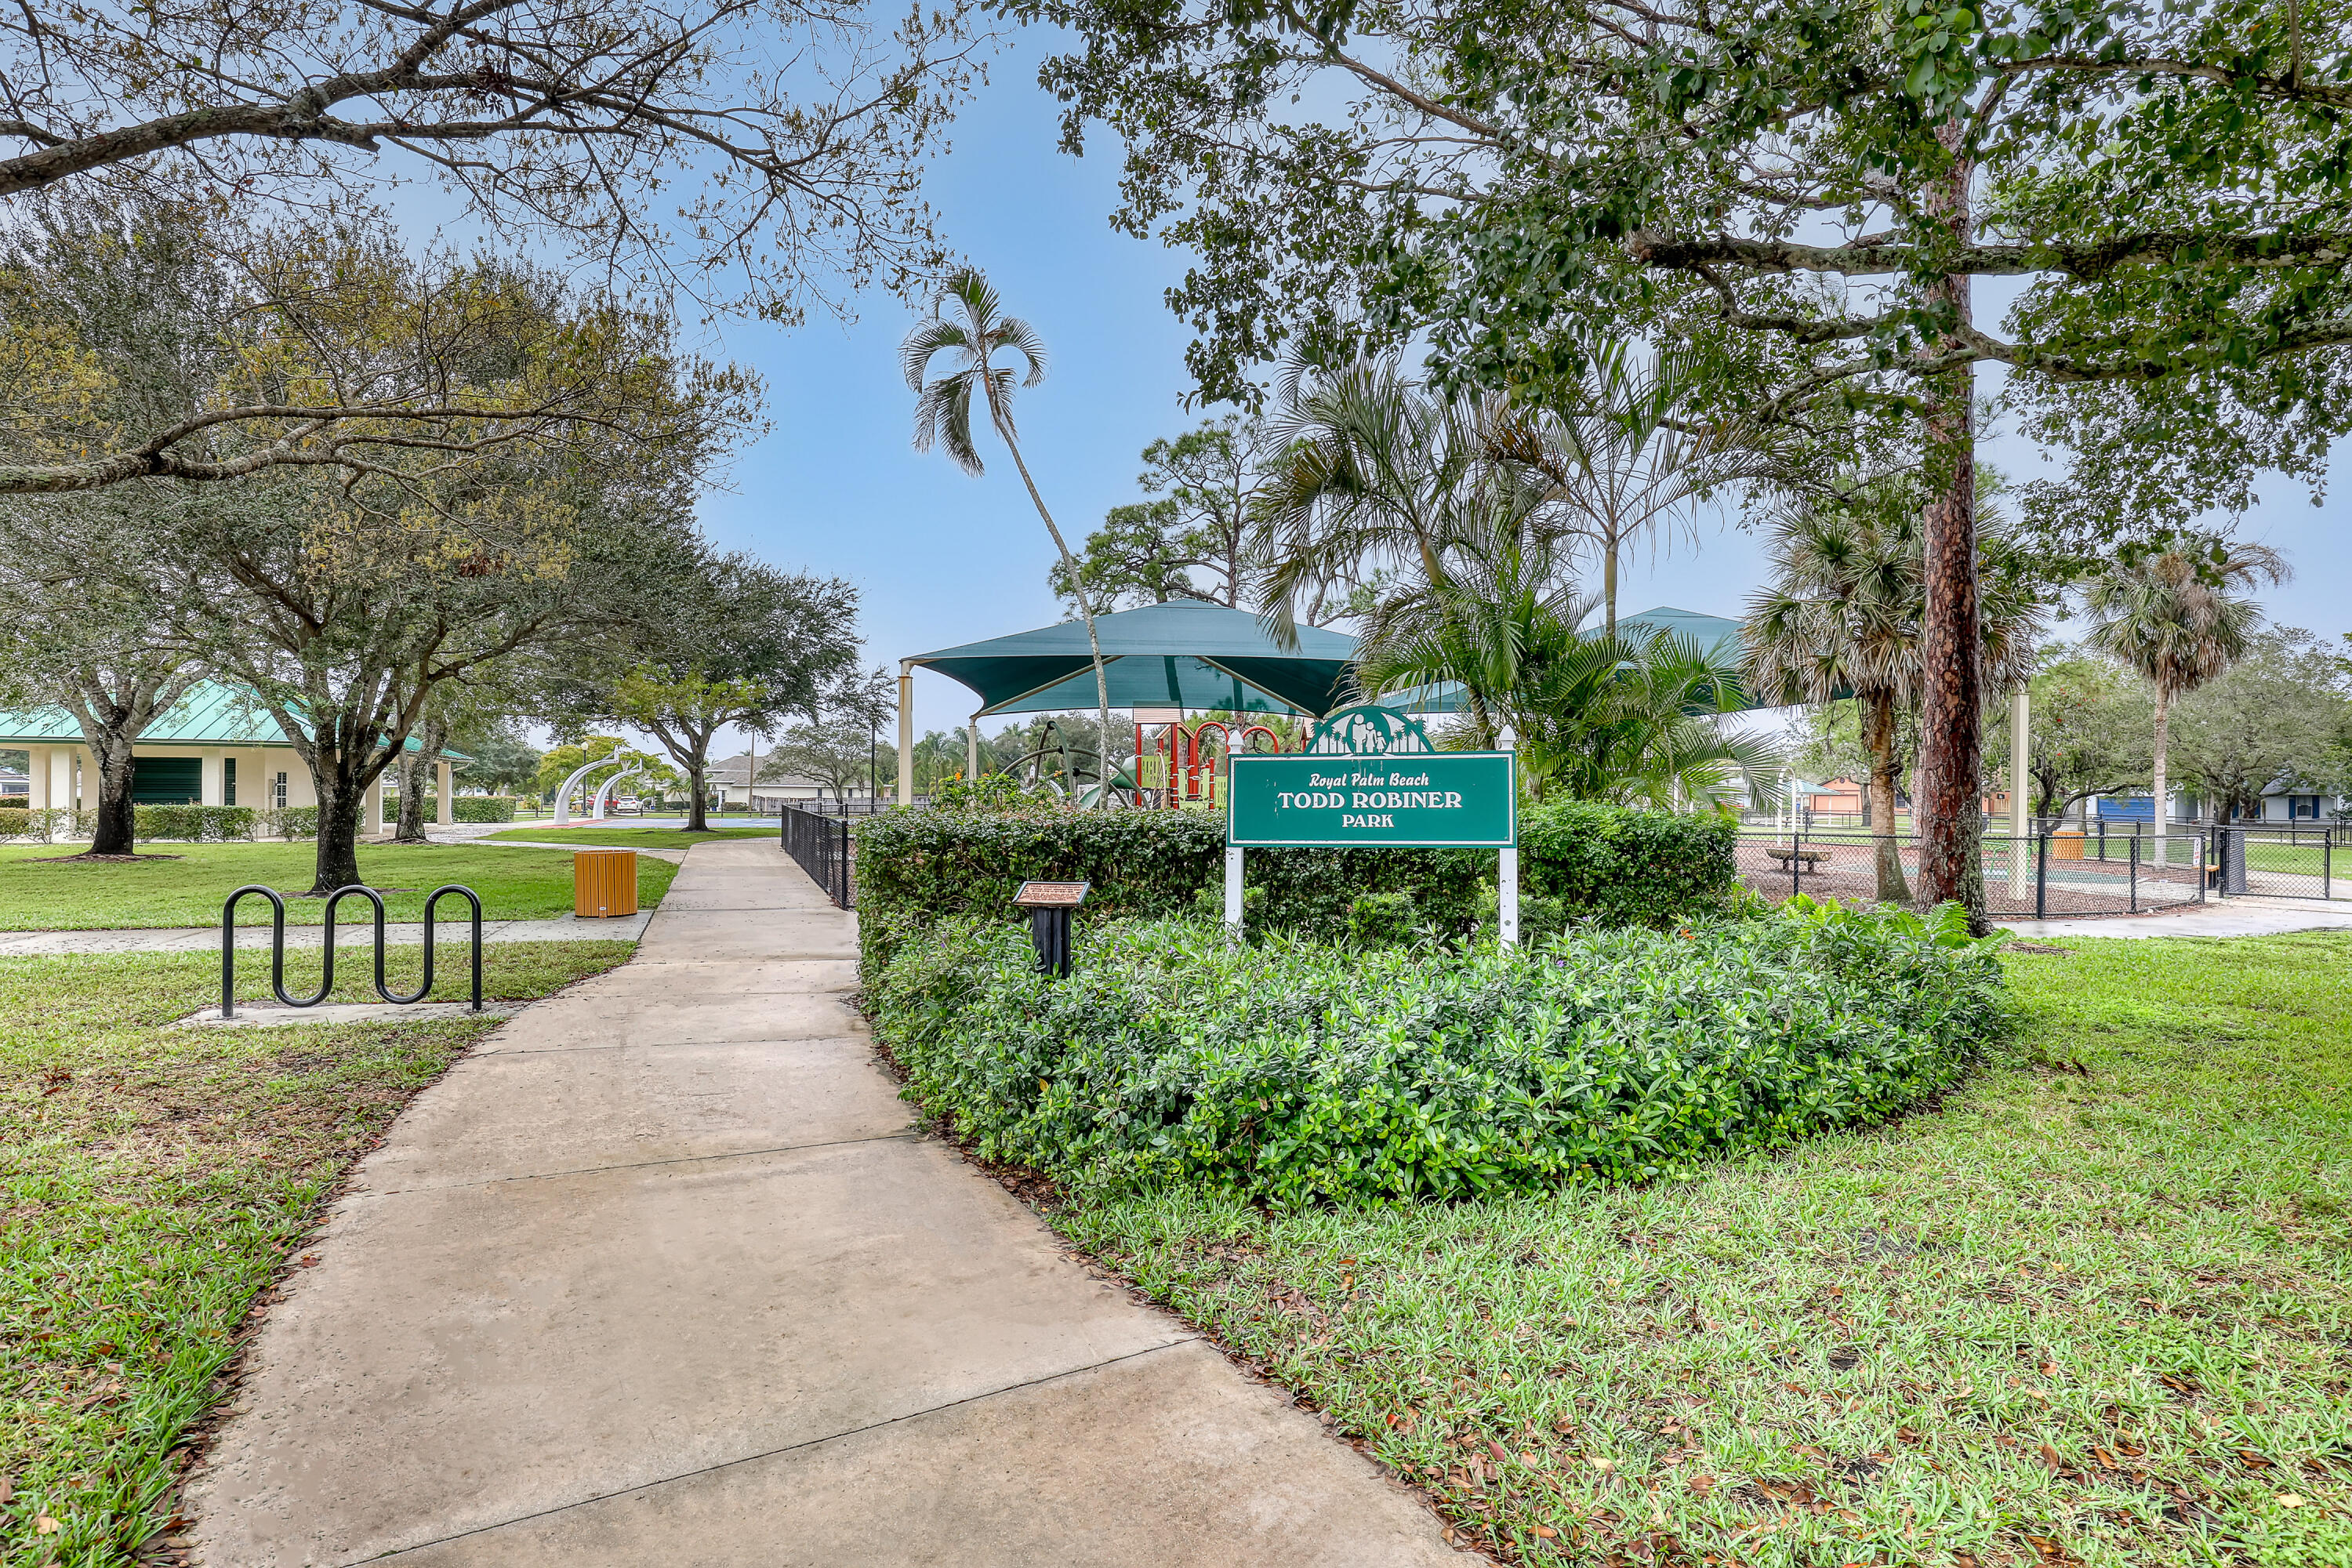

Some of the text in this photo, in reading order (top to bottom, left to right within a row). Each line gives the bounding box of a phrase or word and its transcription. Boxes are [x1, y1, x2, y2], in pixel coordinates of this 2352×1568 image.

[1308, 772, 1429, 789] Royal Palm Beach
[1277, 791, 1463, 808] TODD ROBINER
[1341, 814, 1395, 828] PARK
